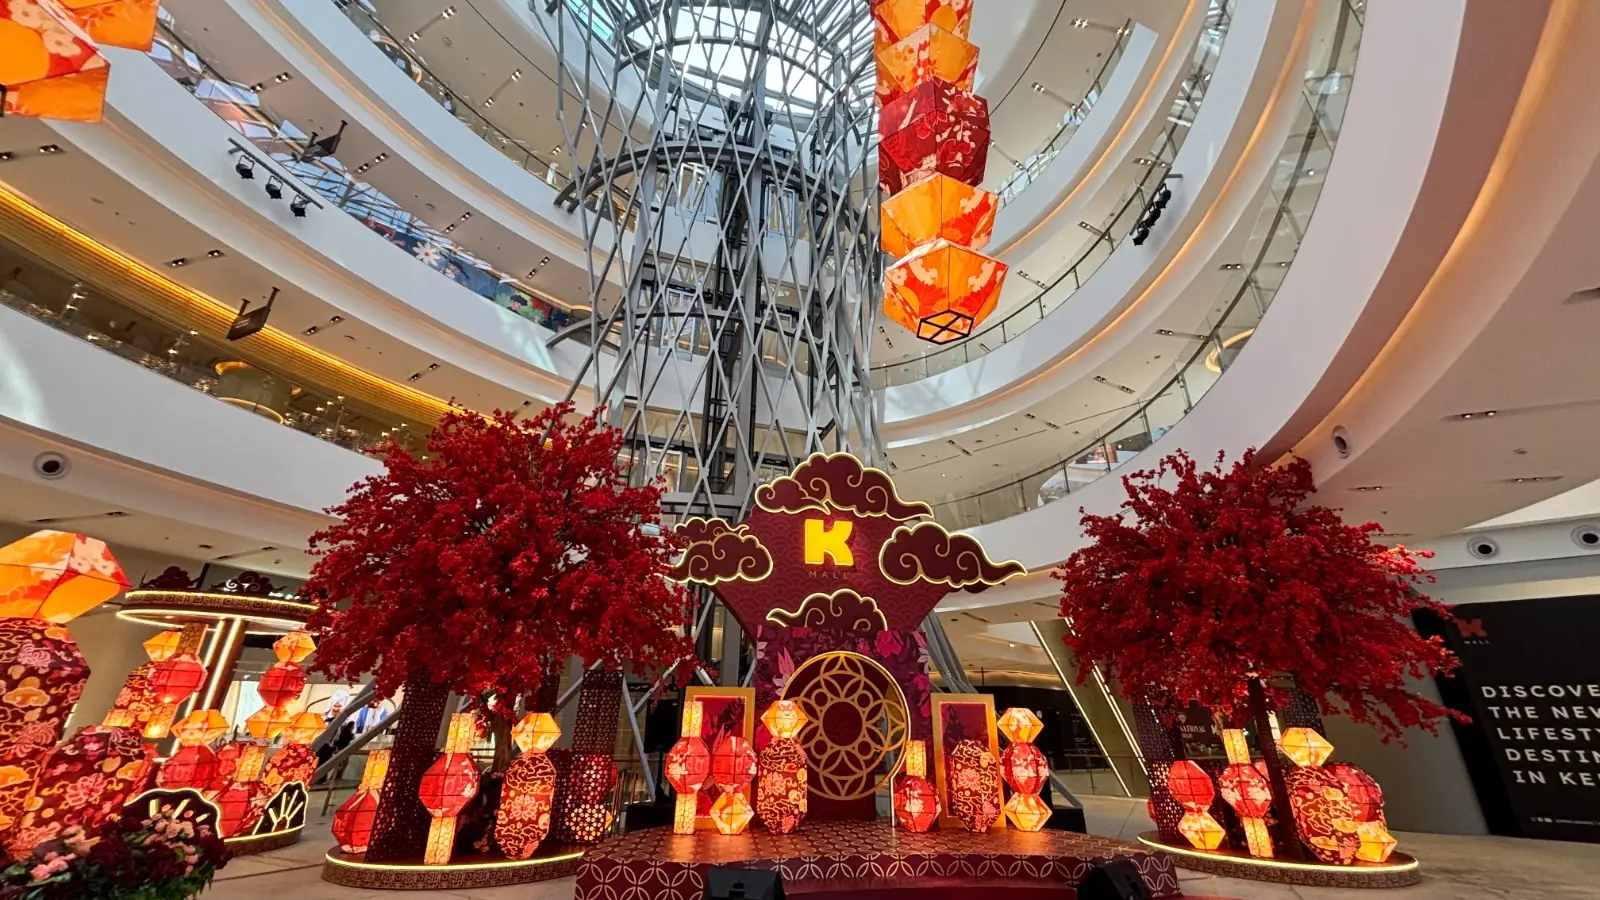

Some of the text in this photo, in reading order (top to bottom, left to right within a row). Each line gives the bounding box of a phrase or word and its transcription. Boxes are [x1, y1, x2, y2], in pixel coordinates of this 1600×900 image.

[804, 518, 855, 567] K
[808, 571, 849, 579] MALL
[1481, 684, 1600, 698] DISCOVE
[1487, 706, 1539, 719] THE
[1496, 727, 1600, 741] LIFEST
[1512, 770, 1600, 786] IN KE
